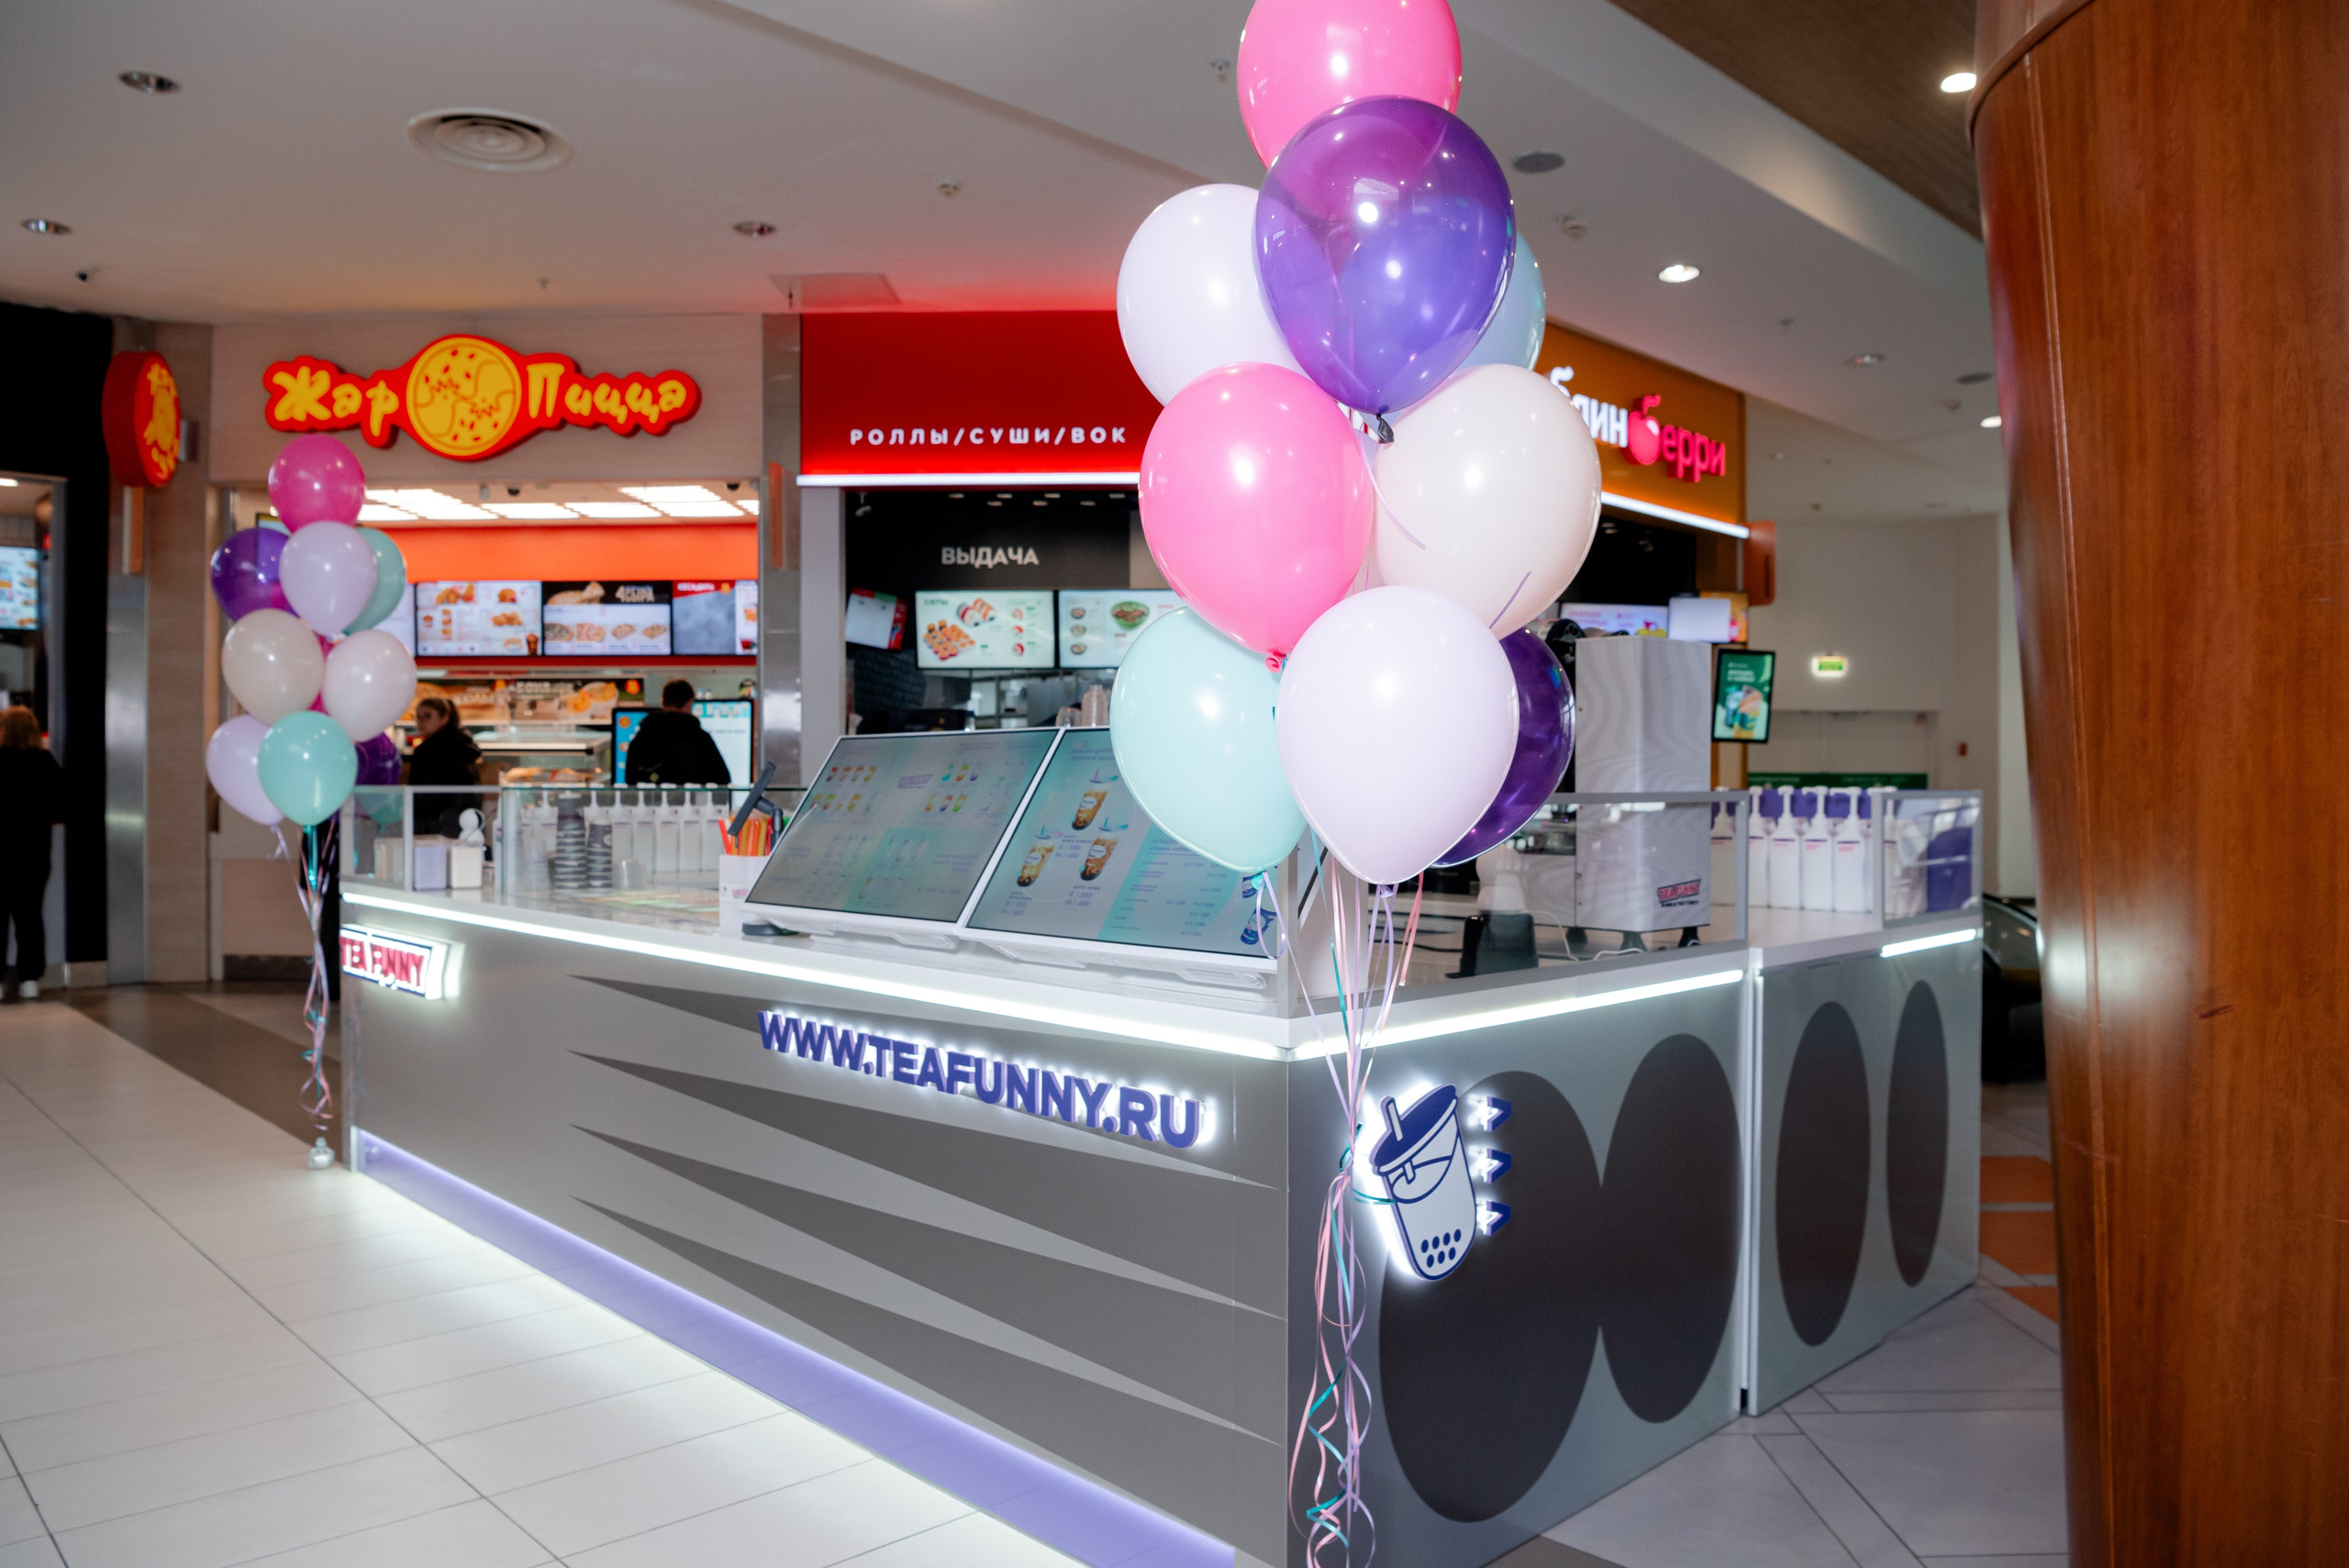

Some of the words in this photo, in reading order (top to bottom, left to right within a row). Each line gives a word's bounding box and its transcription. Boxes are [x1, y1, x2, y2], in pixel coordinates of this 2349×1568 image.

[272, 365, 399, 437] Жар
[526, 362, 686, 424] Пицца
[941, 547, 1040, 569] ВЫДАЧА
[370, 943, 424, 987] FUNNY
[758, 1010, 1200, 1149] WWW.TEAFUNNY.RU
